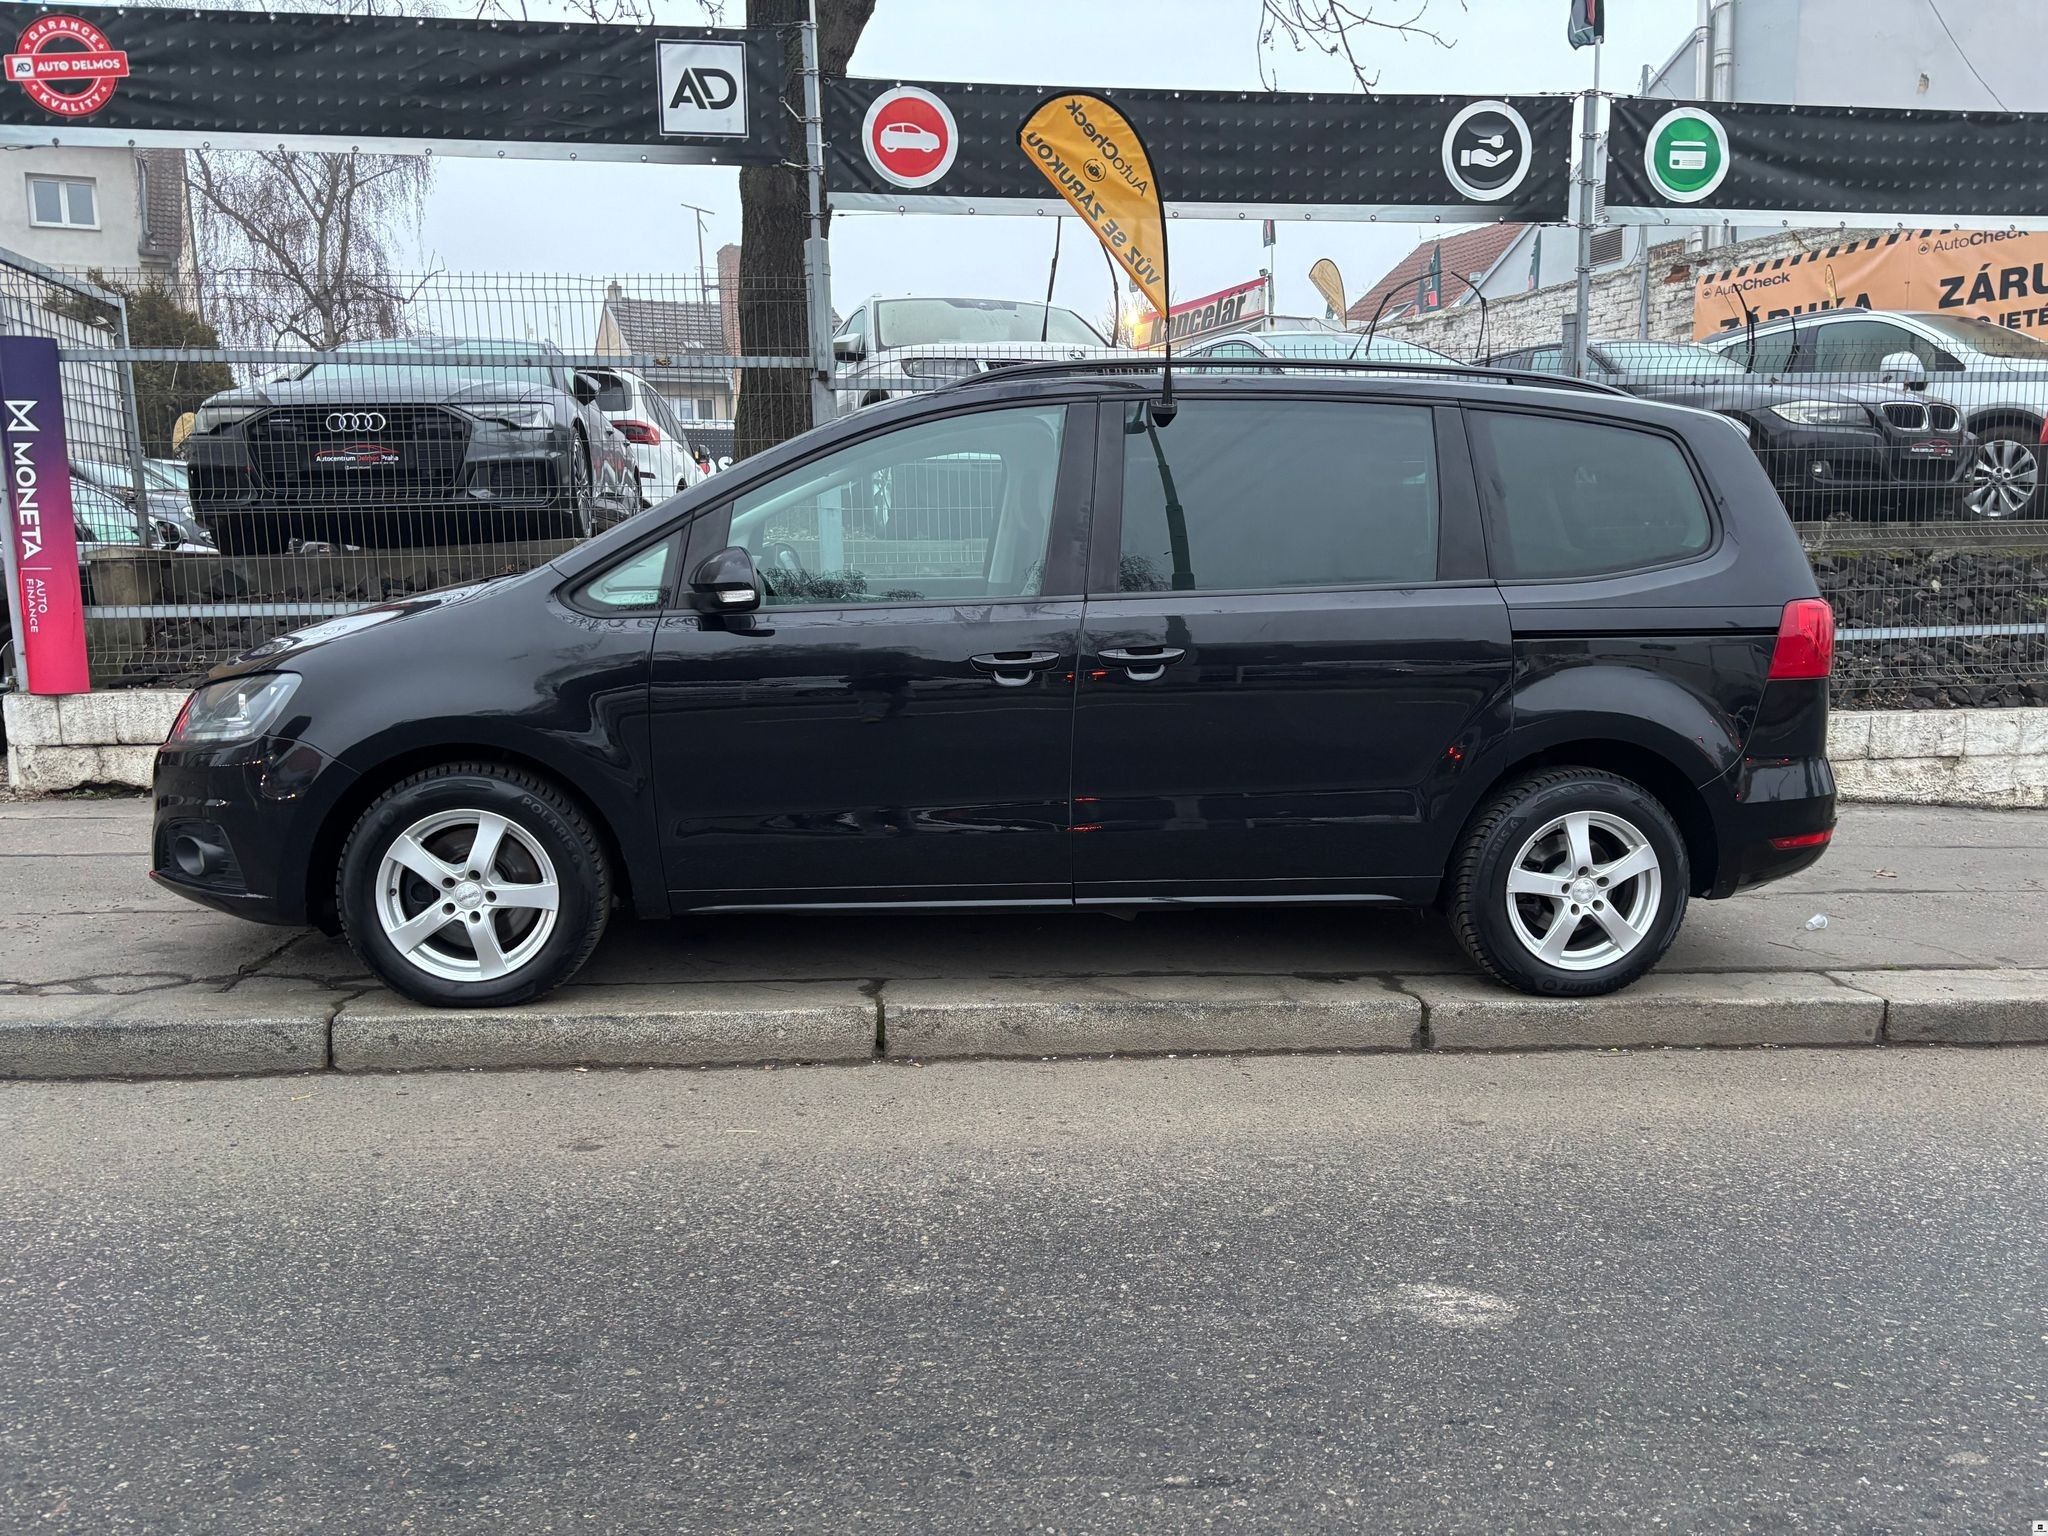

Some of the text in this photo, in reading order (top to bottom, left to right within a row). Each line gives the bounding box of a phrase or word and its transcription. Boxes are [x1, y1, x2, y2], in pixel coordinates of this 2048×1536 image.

[28, 20, 99, 43] GARANCE
[37, 59, 120, 72] AUTO DELMOS
[40, 92, 101, 112] KVALITY
[1714, 272, 1790, 297] AutoCheck
[13, 442, 42, 560] MONETA
[26, 578, 38, 633] FINANCE
[35, 578, 48, 613] AUTO
[521, 796, 577, 850] POLARIS
